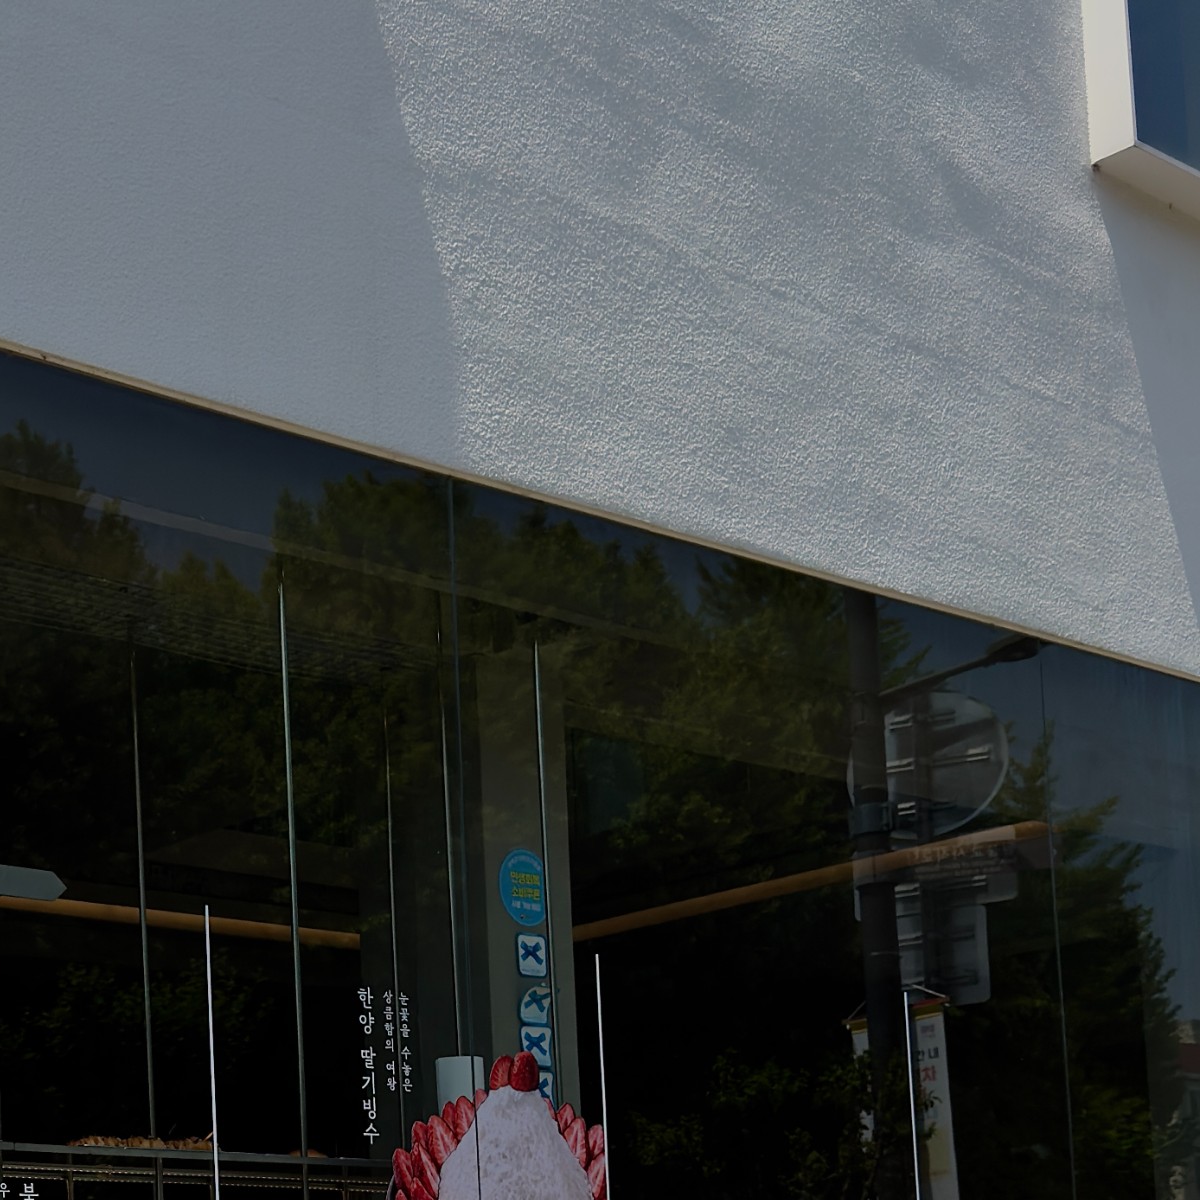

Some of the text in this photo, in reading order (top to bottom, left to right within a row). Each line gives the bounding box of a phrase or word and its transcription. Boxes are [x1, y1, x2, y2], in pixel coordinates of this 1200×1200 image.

[357, 986, 380, 1146] 한양 딸기빙수
[385, 1060, 398, 1093] 여왕
